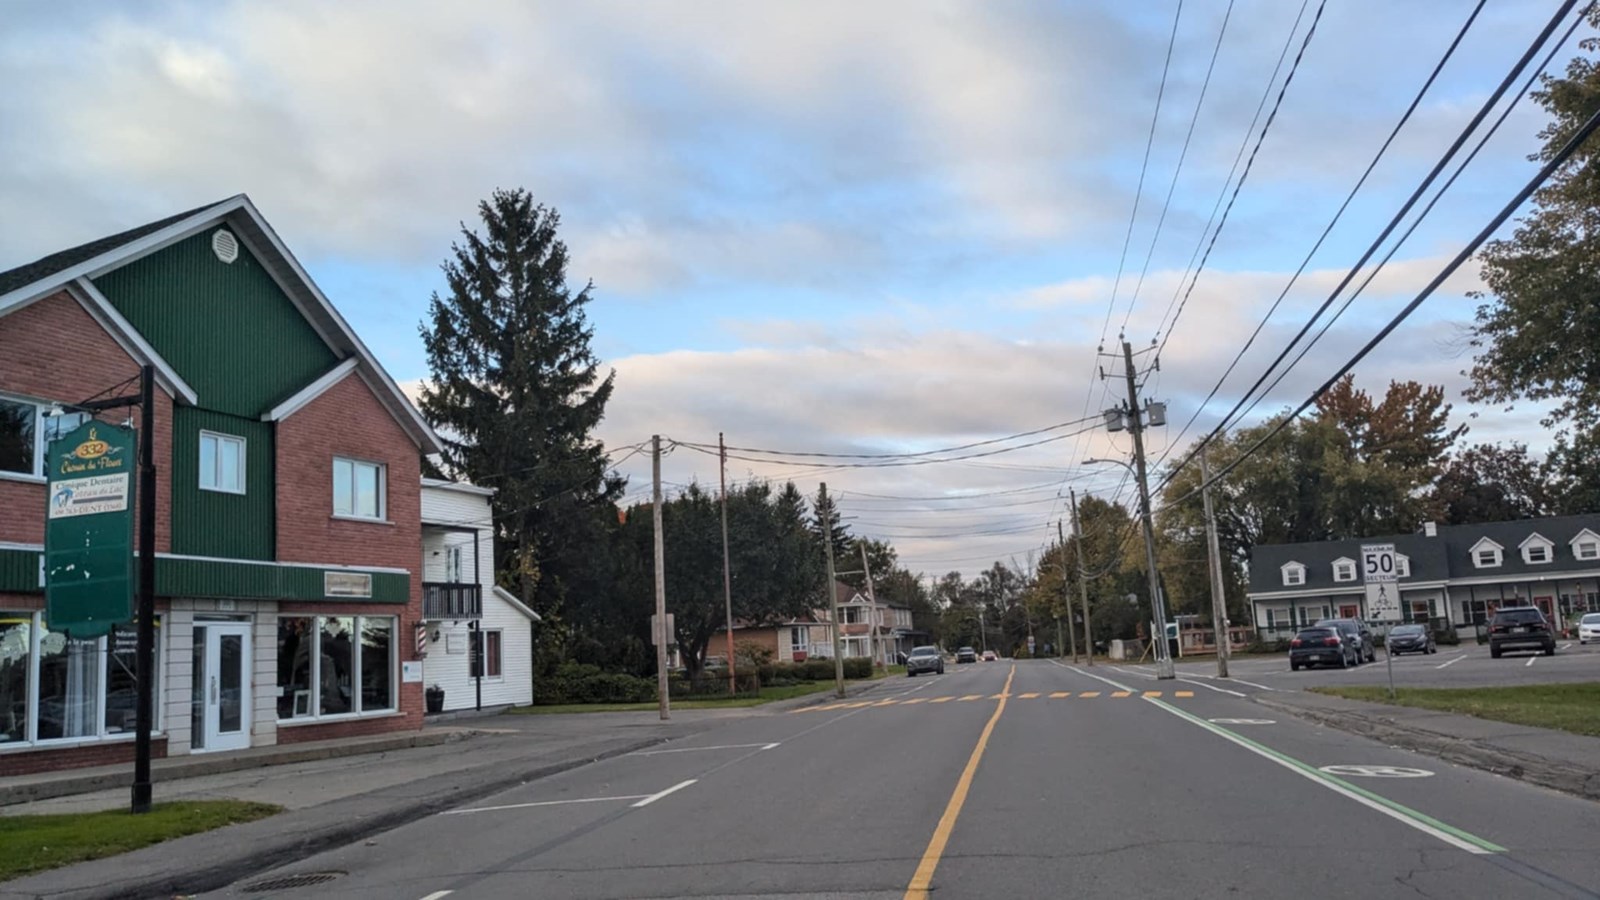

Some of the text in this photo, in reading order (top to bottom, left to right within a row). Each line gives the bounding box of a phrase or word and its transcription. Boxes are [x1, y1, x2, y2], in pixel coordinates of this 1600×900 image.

[81, 443, 104, 456] 332
[56, 475, 124, 490] Clinique Dentaire
[1366, 553, 1392, 573] 50
